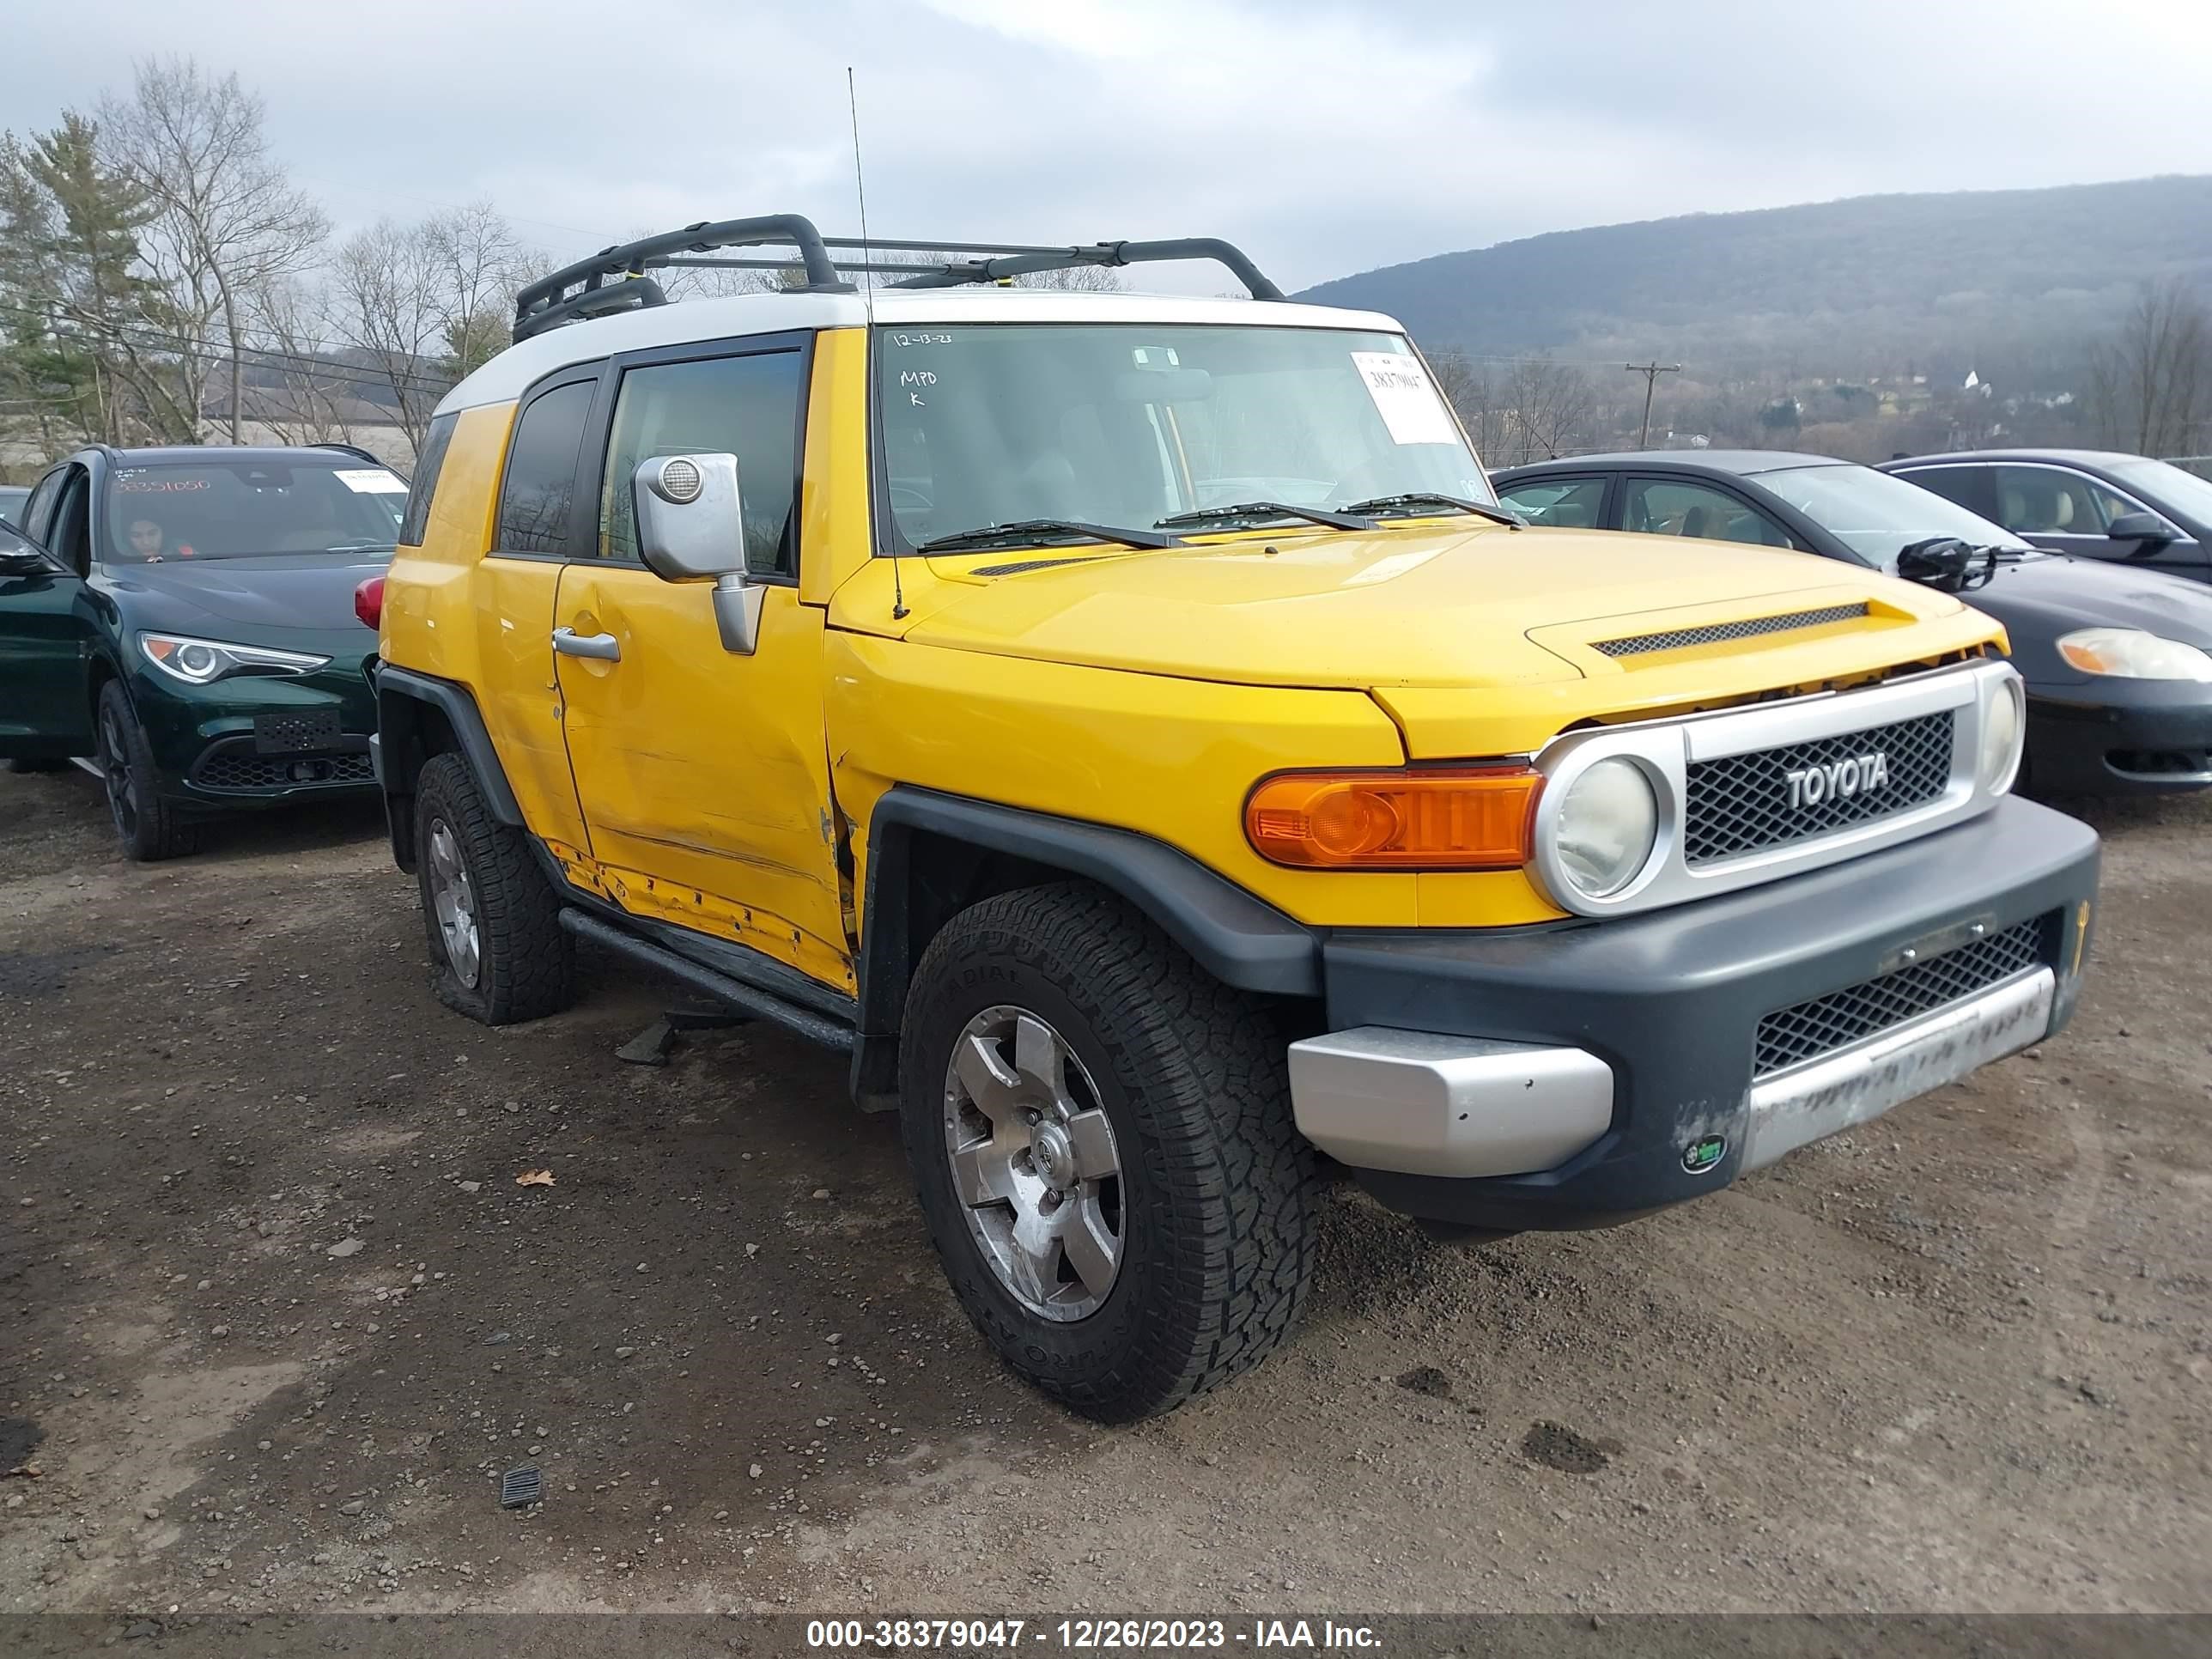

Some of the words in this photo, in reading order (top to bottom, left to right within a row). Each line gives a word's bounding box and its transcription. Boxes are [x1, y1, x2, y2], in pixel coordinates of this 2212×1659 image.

[893, 334, 952, 347] 12-13-23
[900, 370, 937, 387] MPD
[910, 392, 926, 407] K
[1786, 752, 1889, 808] TOYOTA
